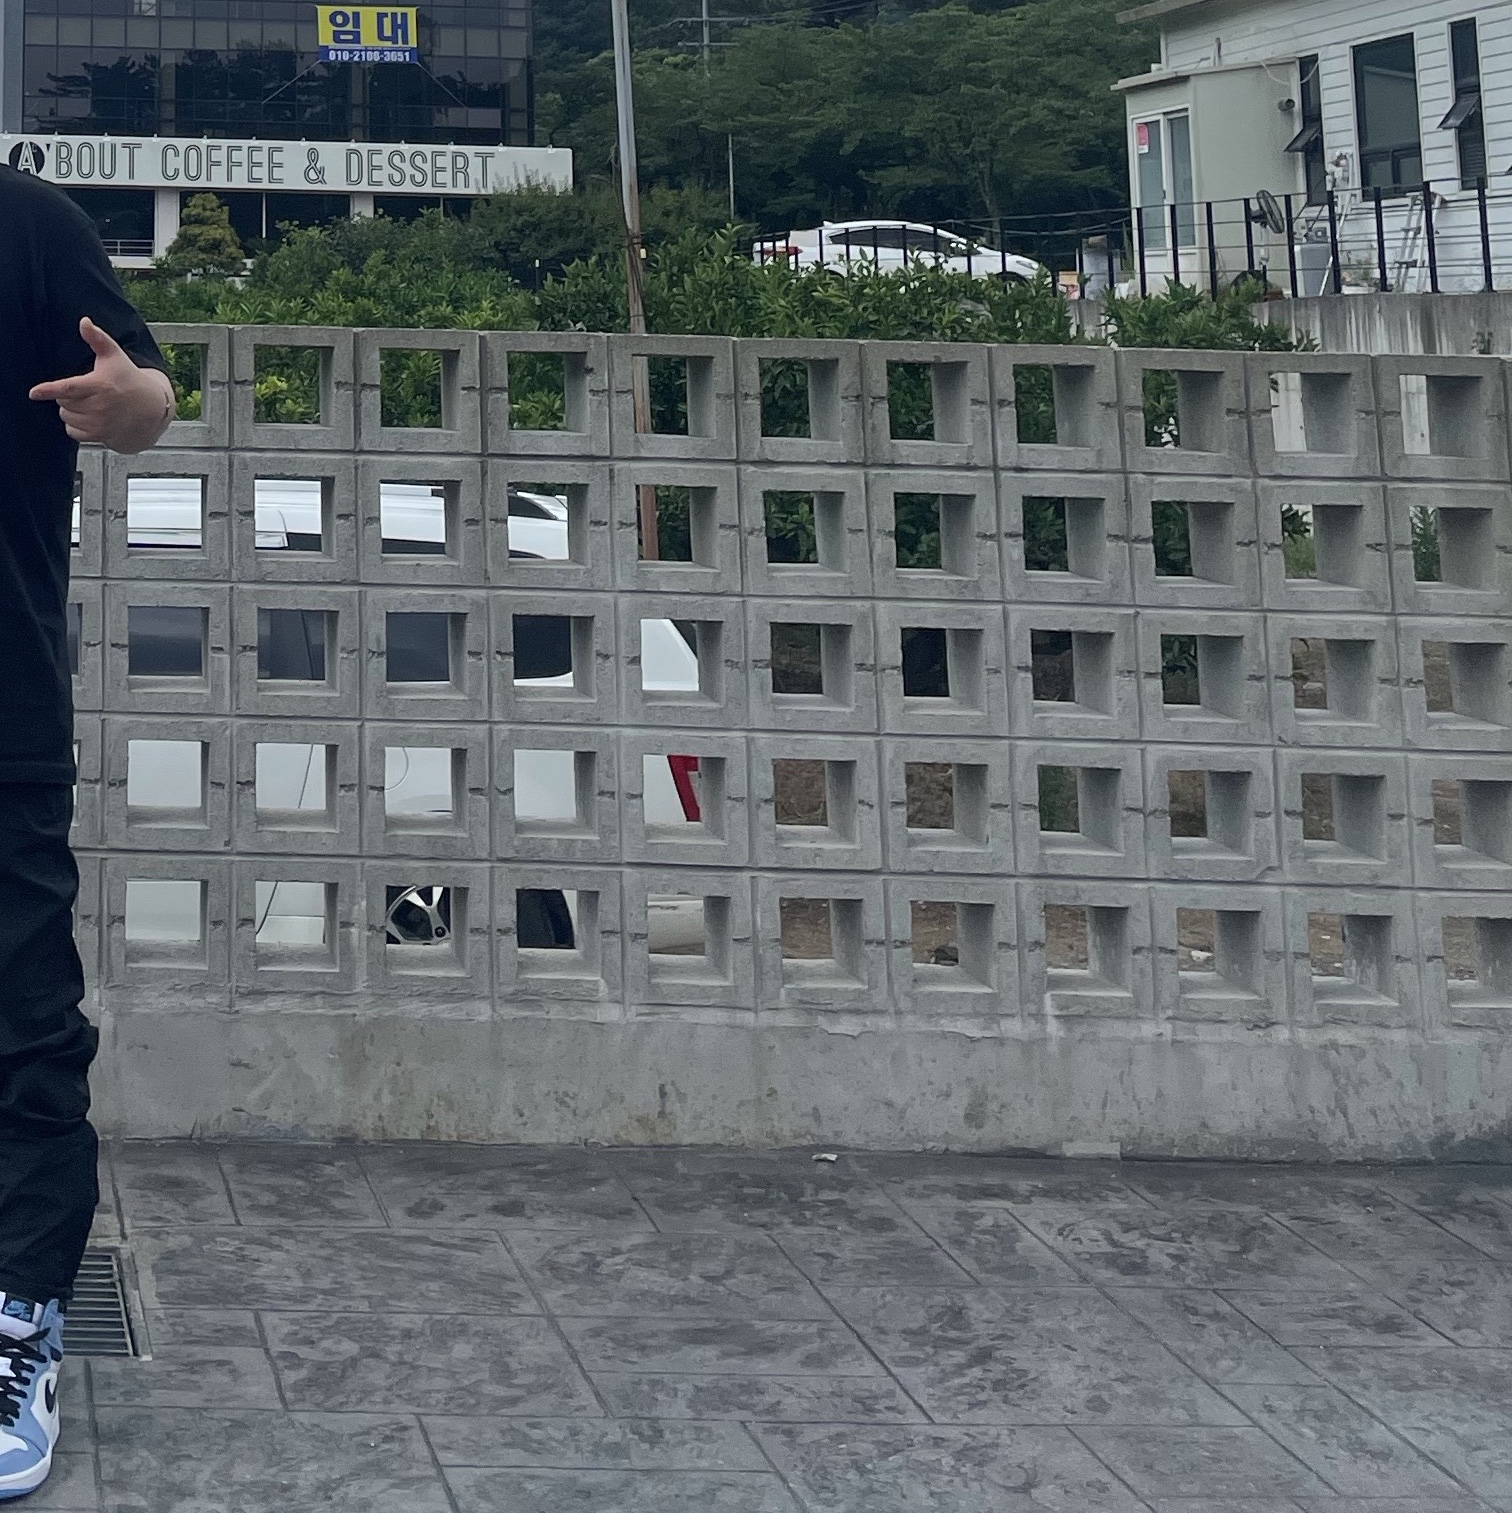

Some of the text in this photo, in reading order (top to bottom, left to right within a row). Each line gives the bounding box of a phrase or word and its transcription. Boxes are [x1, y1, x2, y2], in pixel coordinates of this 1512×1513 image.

[161, 144, 284, 183] COFFEE
[304, 148, 327, 185] &
[345, 148, 495, 190] DESSERT
